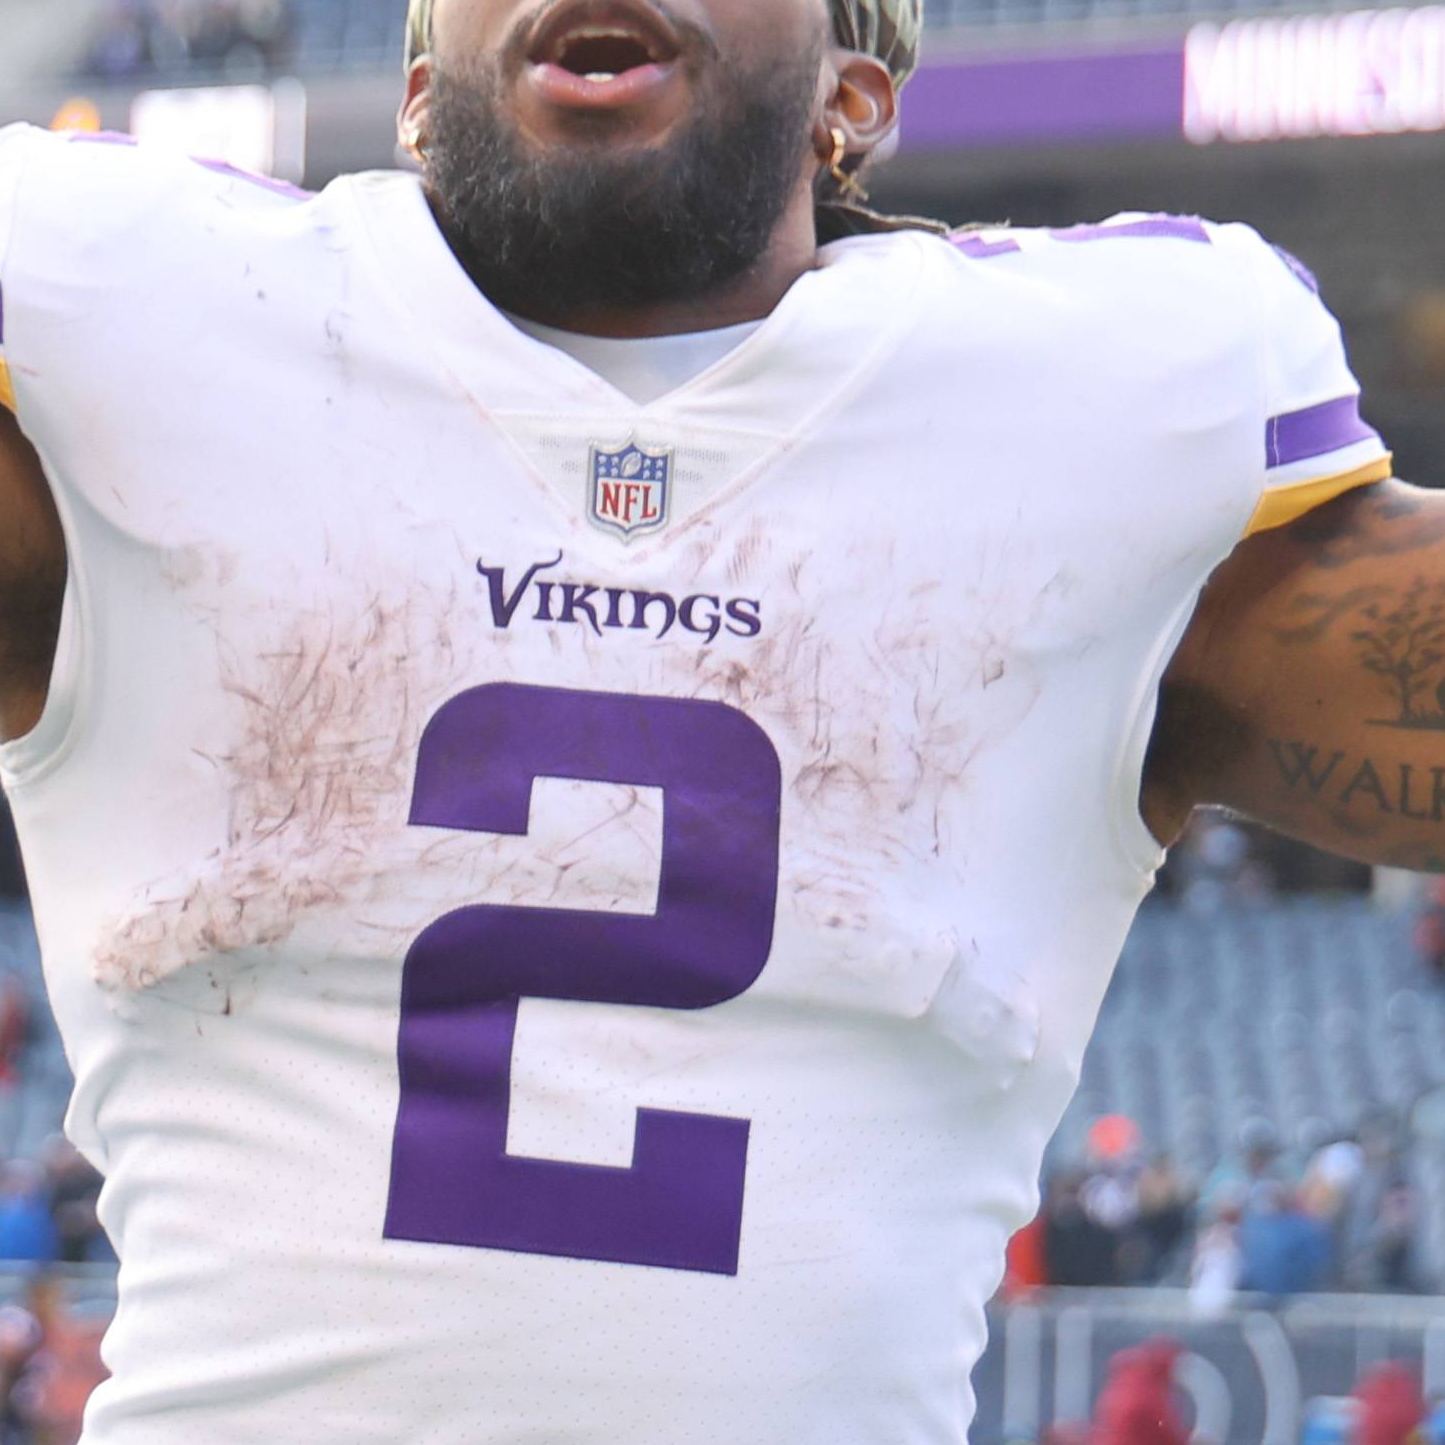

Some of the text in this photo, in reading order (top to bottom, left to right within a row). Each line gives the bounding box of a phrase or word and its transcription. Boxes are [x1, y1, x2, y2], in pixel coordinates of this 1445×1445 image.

[600, 481, 658, 523] NFL
[476, 548, 762, 645] VIKINGS
[382, 681, 782, 1277] 2
